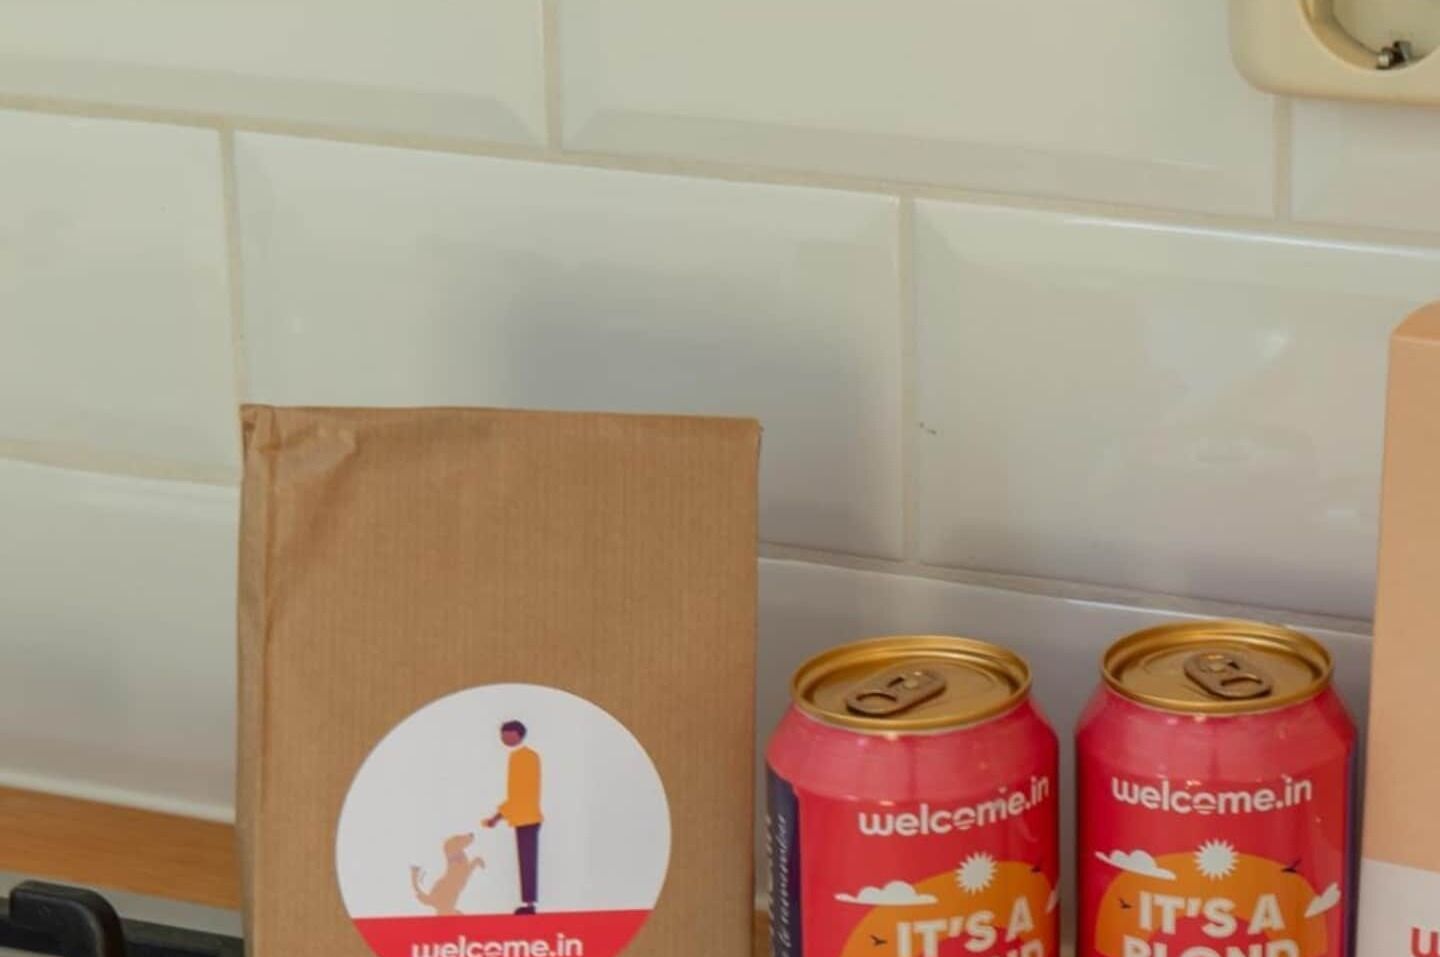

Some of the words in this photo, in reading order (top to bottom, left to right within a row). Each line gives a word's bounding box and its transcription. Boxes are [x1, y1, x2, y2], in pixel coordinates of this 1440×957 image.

[858, 775, 1050, 836] welcome.in
[1111, 775, 1312, 815] welcome.in
[1008, 895, 1034, 941] A
[1138, 891, 1237, 938] IT'S
[1247, 894, 1285, 935] A
